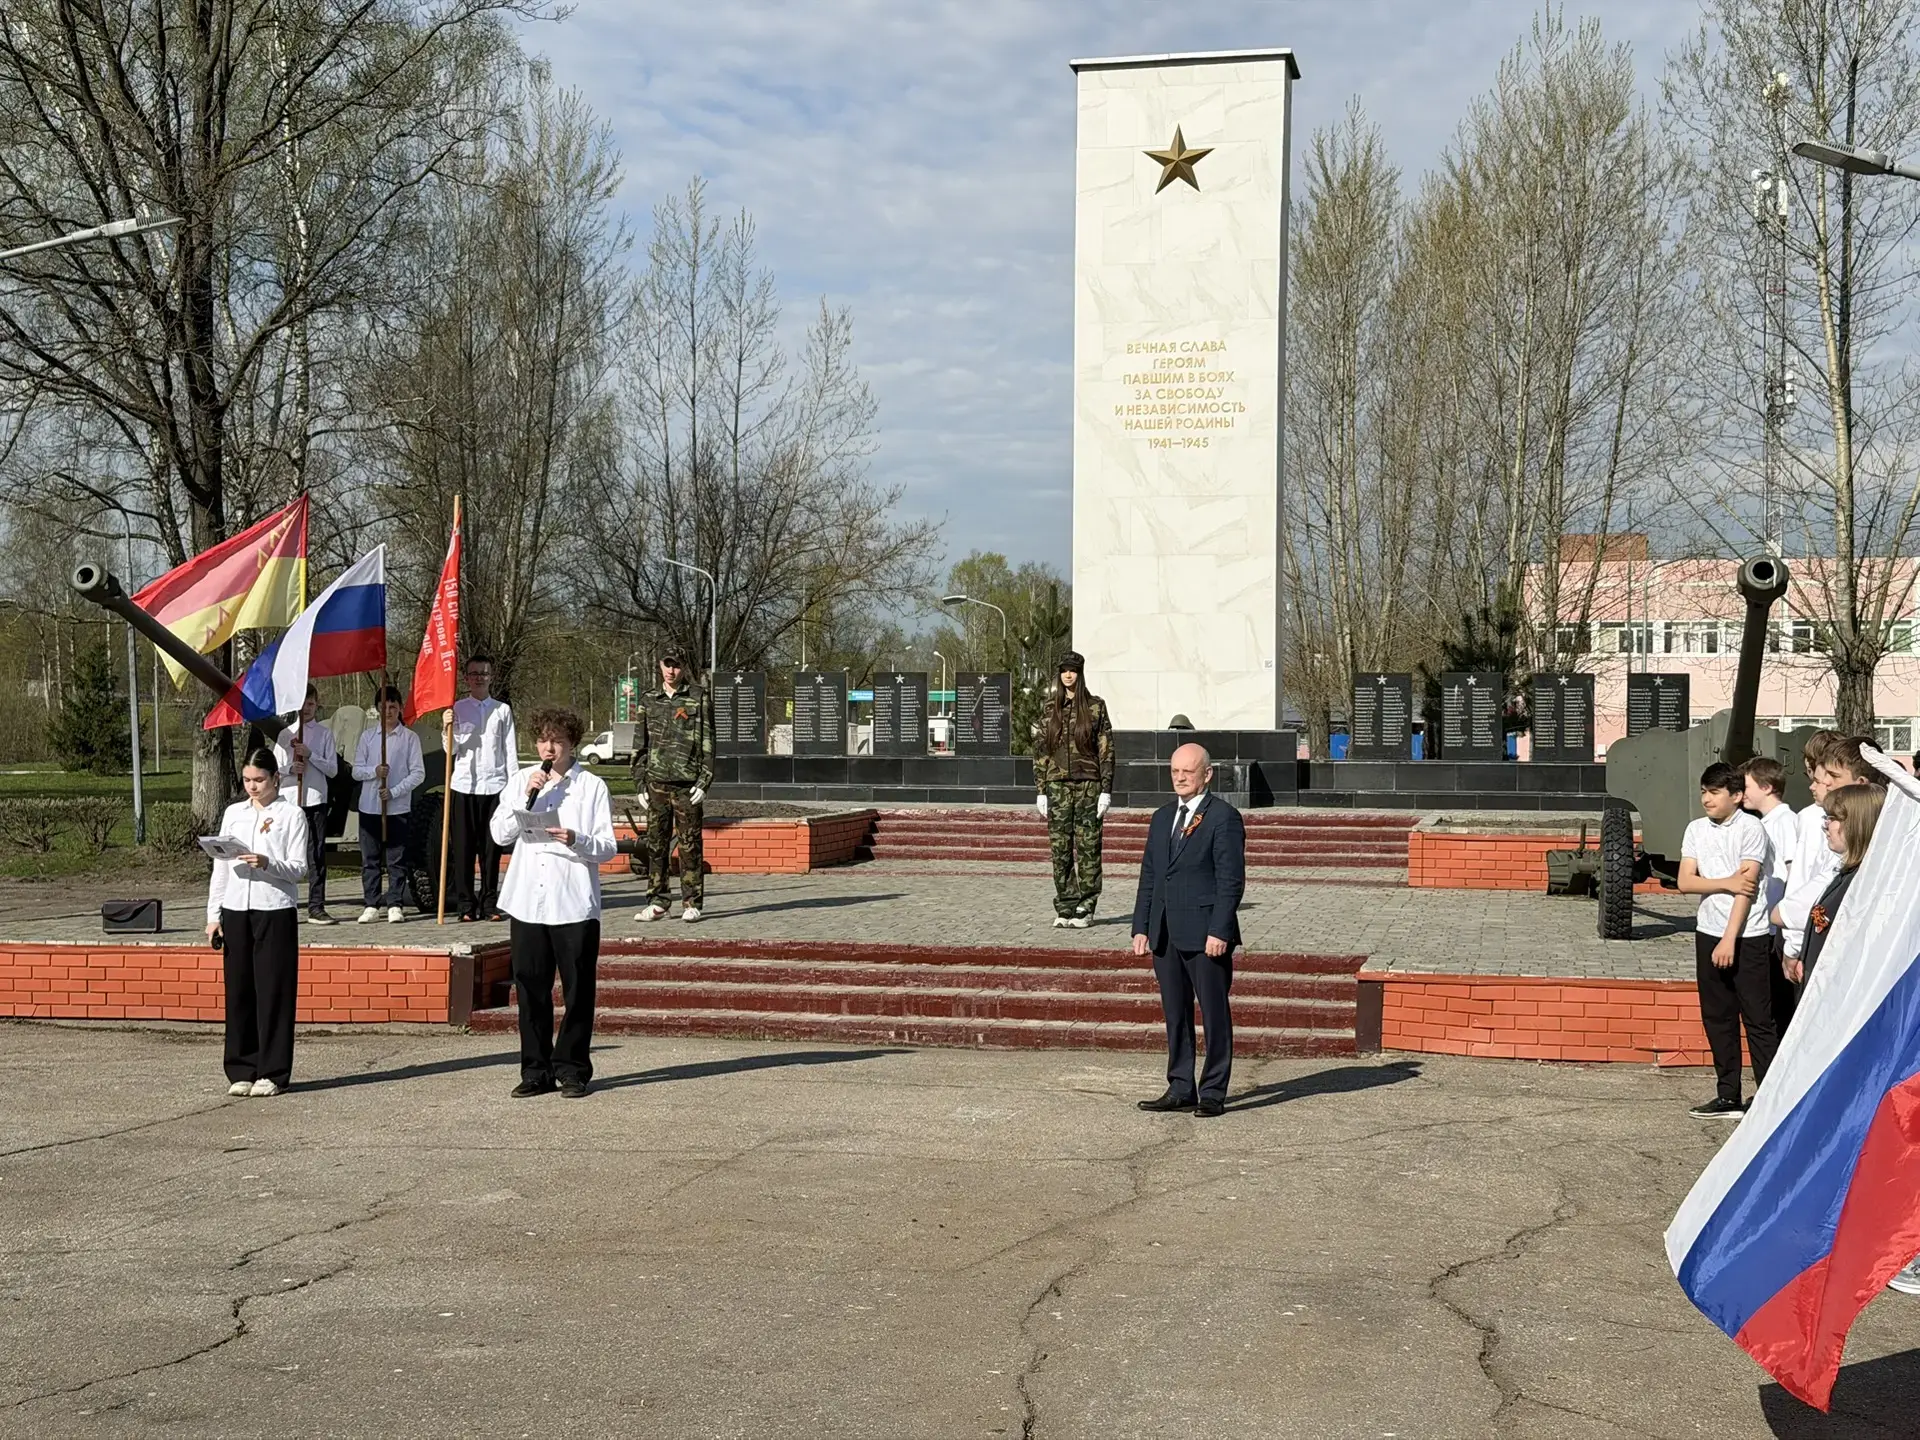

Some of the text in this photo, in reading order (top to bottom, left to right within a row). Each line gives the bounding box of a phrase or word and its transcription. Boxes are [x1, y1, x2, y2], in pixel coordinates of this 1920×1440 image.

[1126, 340, 1227, 354] ВЕЧНАЯ СЛАВА
[1152, 357, 1206, 370] ГЕРОЯМ
[1122, 371, 1235, 385] ПАВШИМ В БОЯХ
[1135, 387, 1225, 400] ЗА СВОБОДУ
[1114, 401, 1246, 416] И НЕЗАВИСИМОСТЬ
[1124, 416, 1235, 430] НАШЕЙ РОДИНЫ
[443, 577, 459, 599] 150
